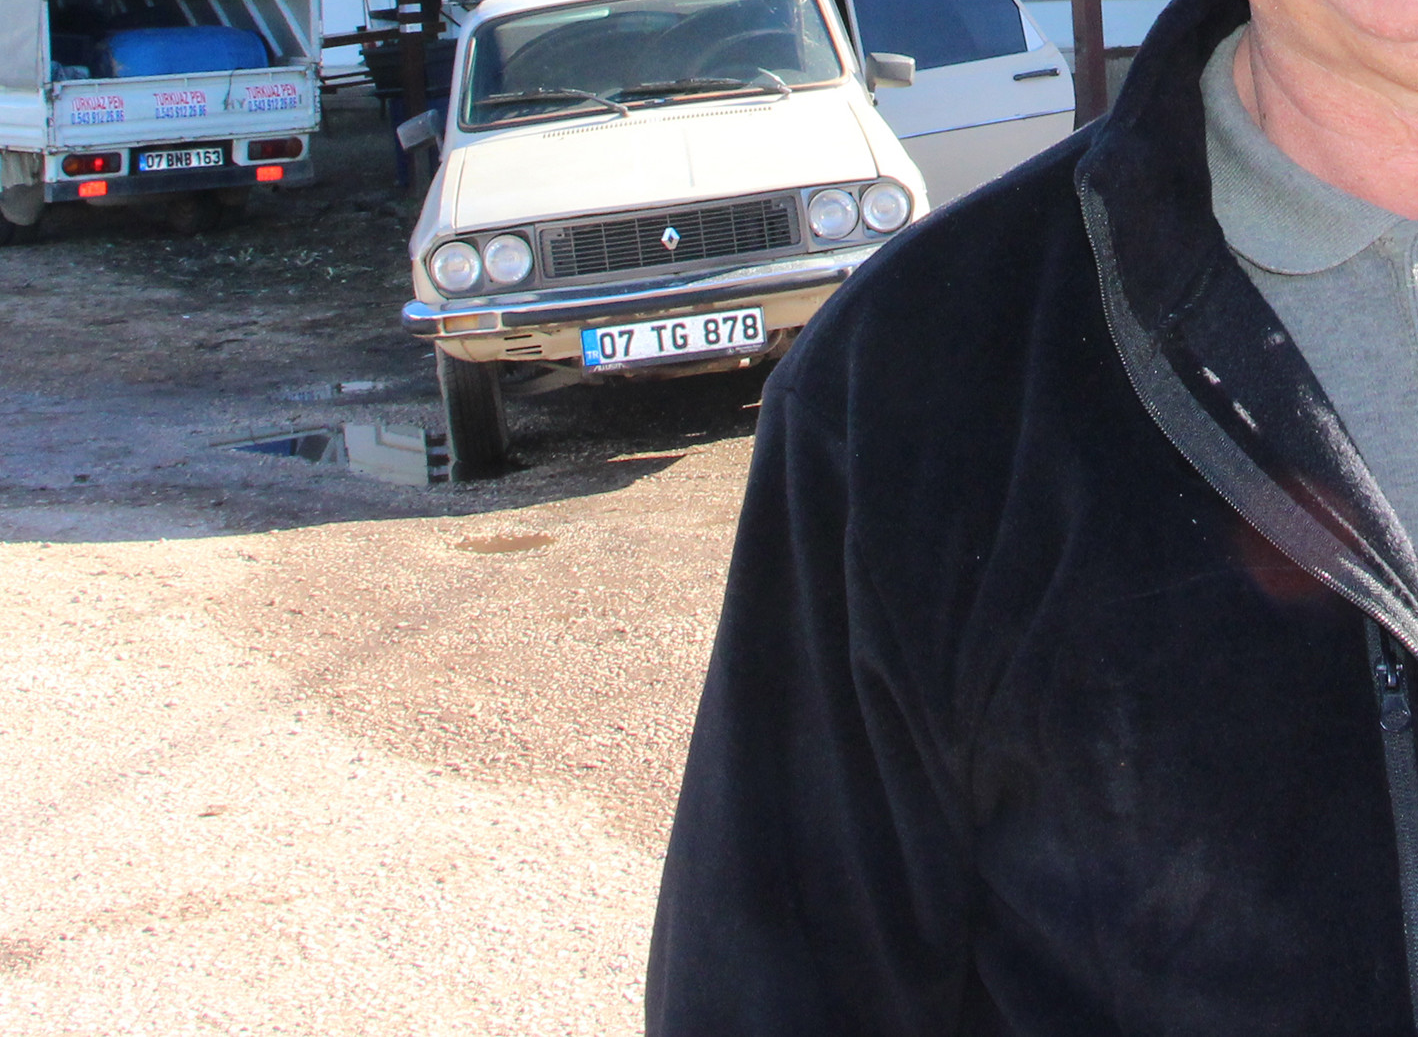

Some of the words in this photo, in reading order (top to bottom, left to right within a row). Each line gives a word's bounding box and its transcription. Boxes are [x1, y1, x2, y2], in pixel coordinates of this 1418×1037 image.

[146, 153, 163, 169] 07
[166, 152, 192, 167] BNB
[196, 150, 220, 165] 163
[600, 329, 635, 359] 07
[651, 323, 688, 353] TG
[704, 313, 759, 345] 878
[586, 351, 599, 359] TR
